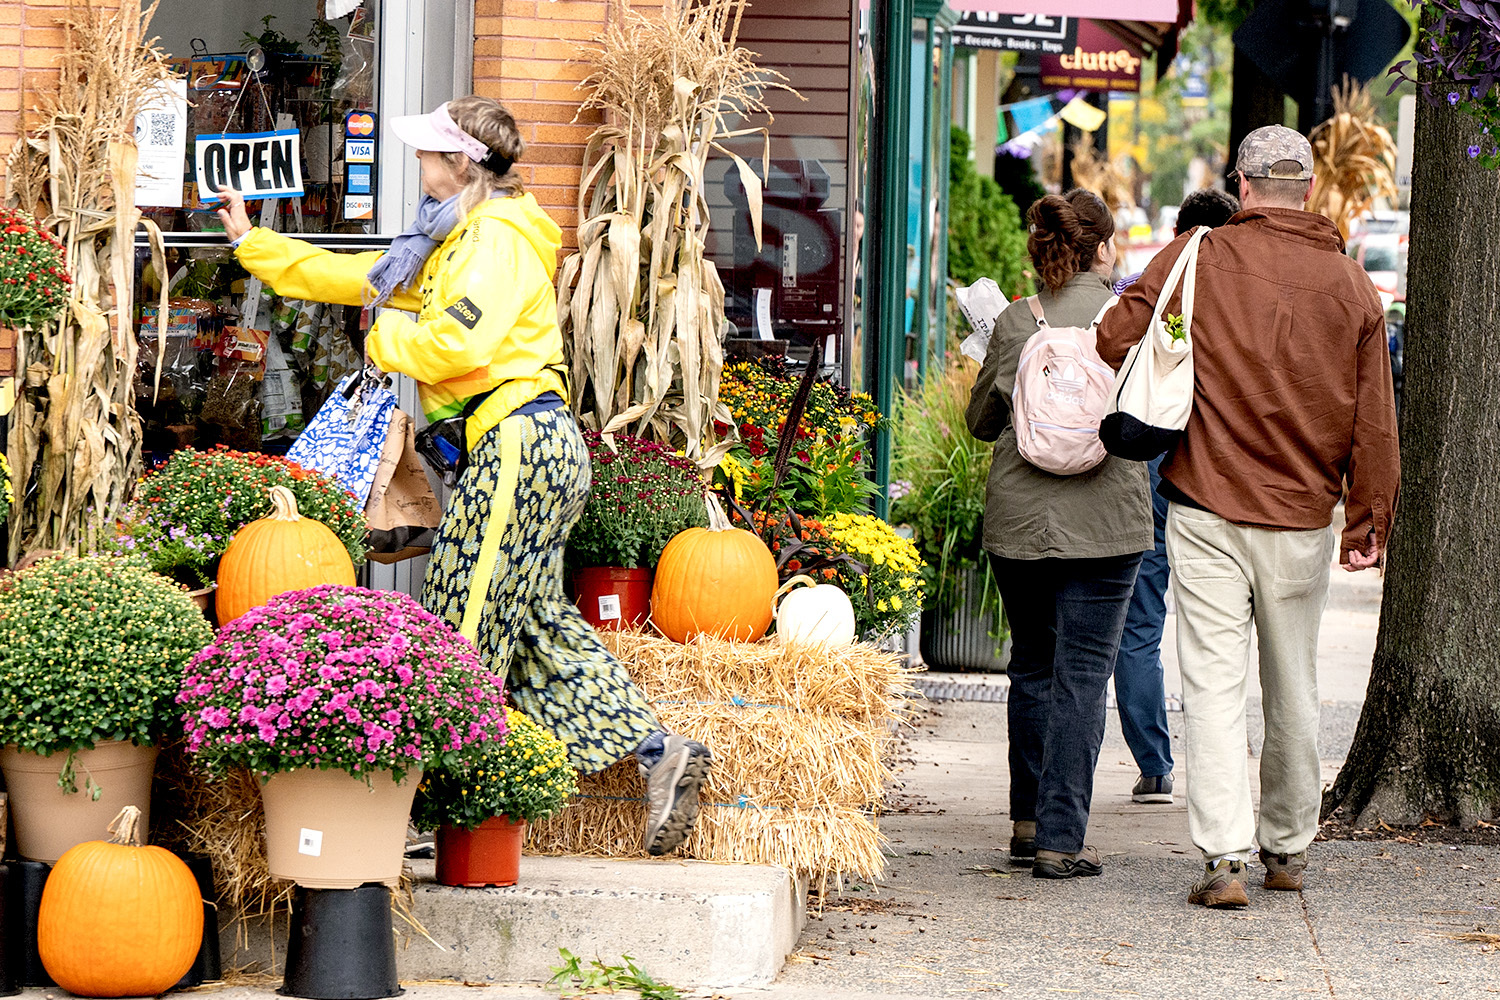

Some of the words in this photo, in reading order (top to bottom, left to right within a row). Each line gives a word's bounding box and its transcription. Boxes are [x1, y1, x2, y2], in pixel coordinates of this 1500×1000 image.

[964, 34, 1003, 48] Records
[1060, 46, 1141, 75] clutter
[351, 146, 370, 156] VISA
[203, 139, 296, 194] OPEN
[346, 201, 371, 209] DISCOVER
[1046, 391, 1086, 406] adidas
